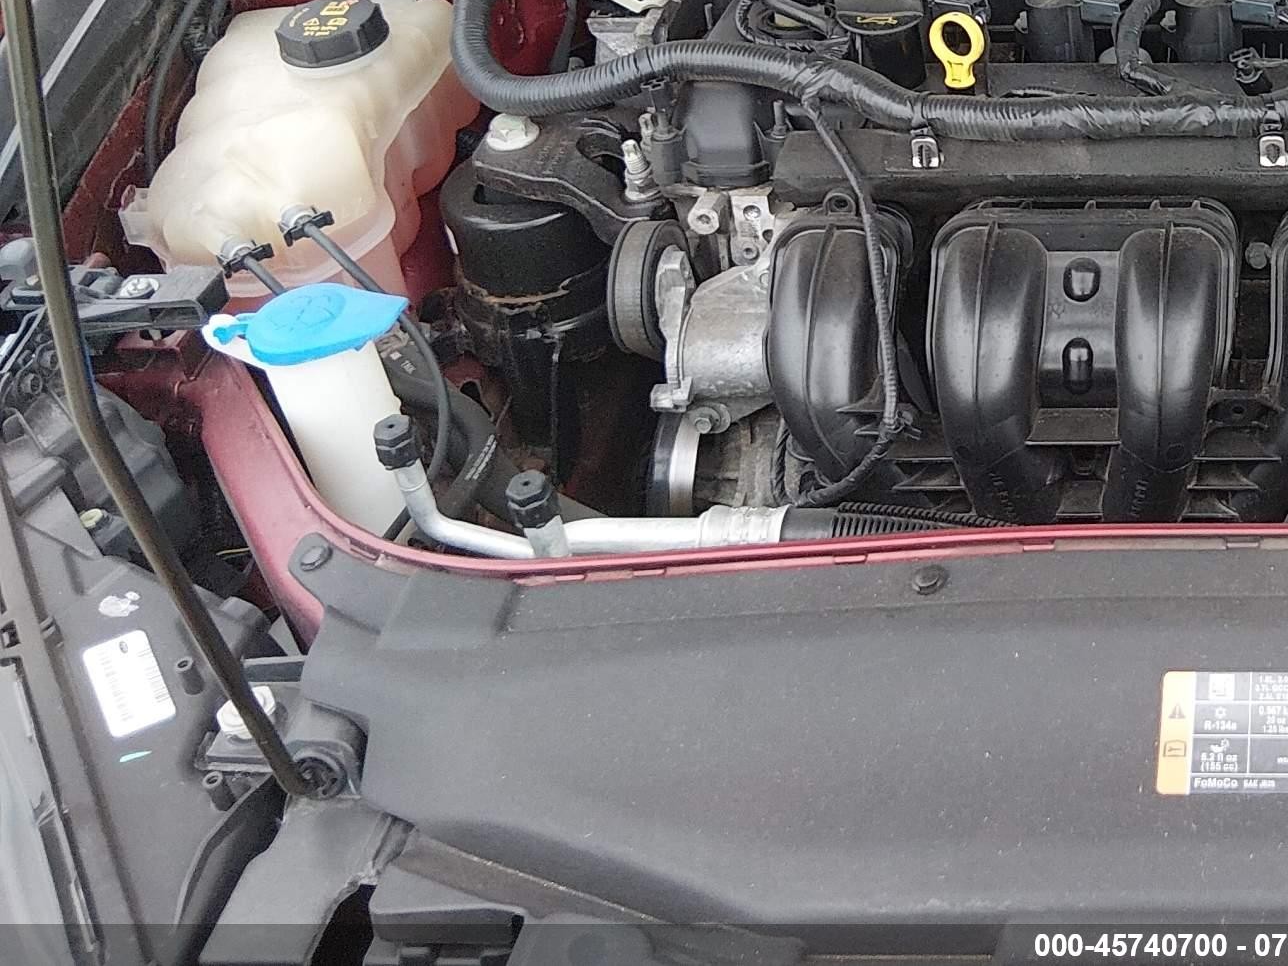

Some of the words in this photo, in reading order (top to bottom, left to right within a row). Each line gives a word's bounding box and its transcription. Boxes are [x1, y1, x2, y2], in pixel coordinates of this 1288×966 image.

[1204, 720, 1237, 730] R-134a
[1226, 754, 1238, 762] oz
[1194, 777, 1238, 788] FoMoCo
